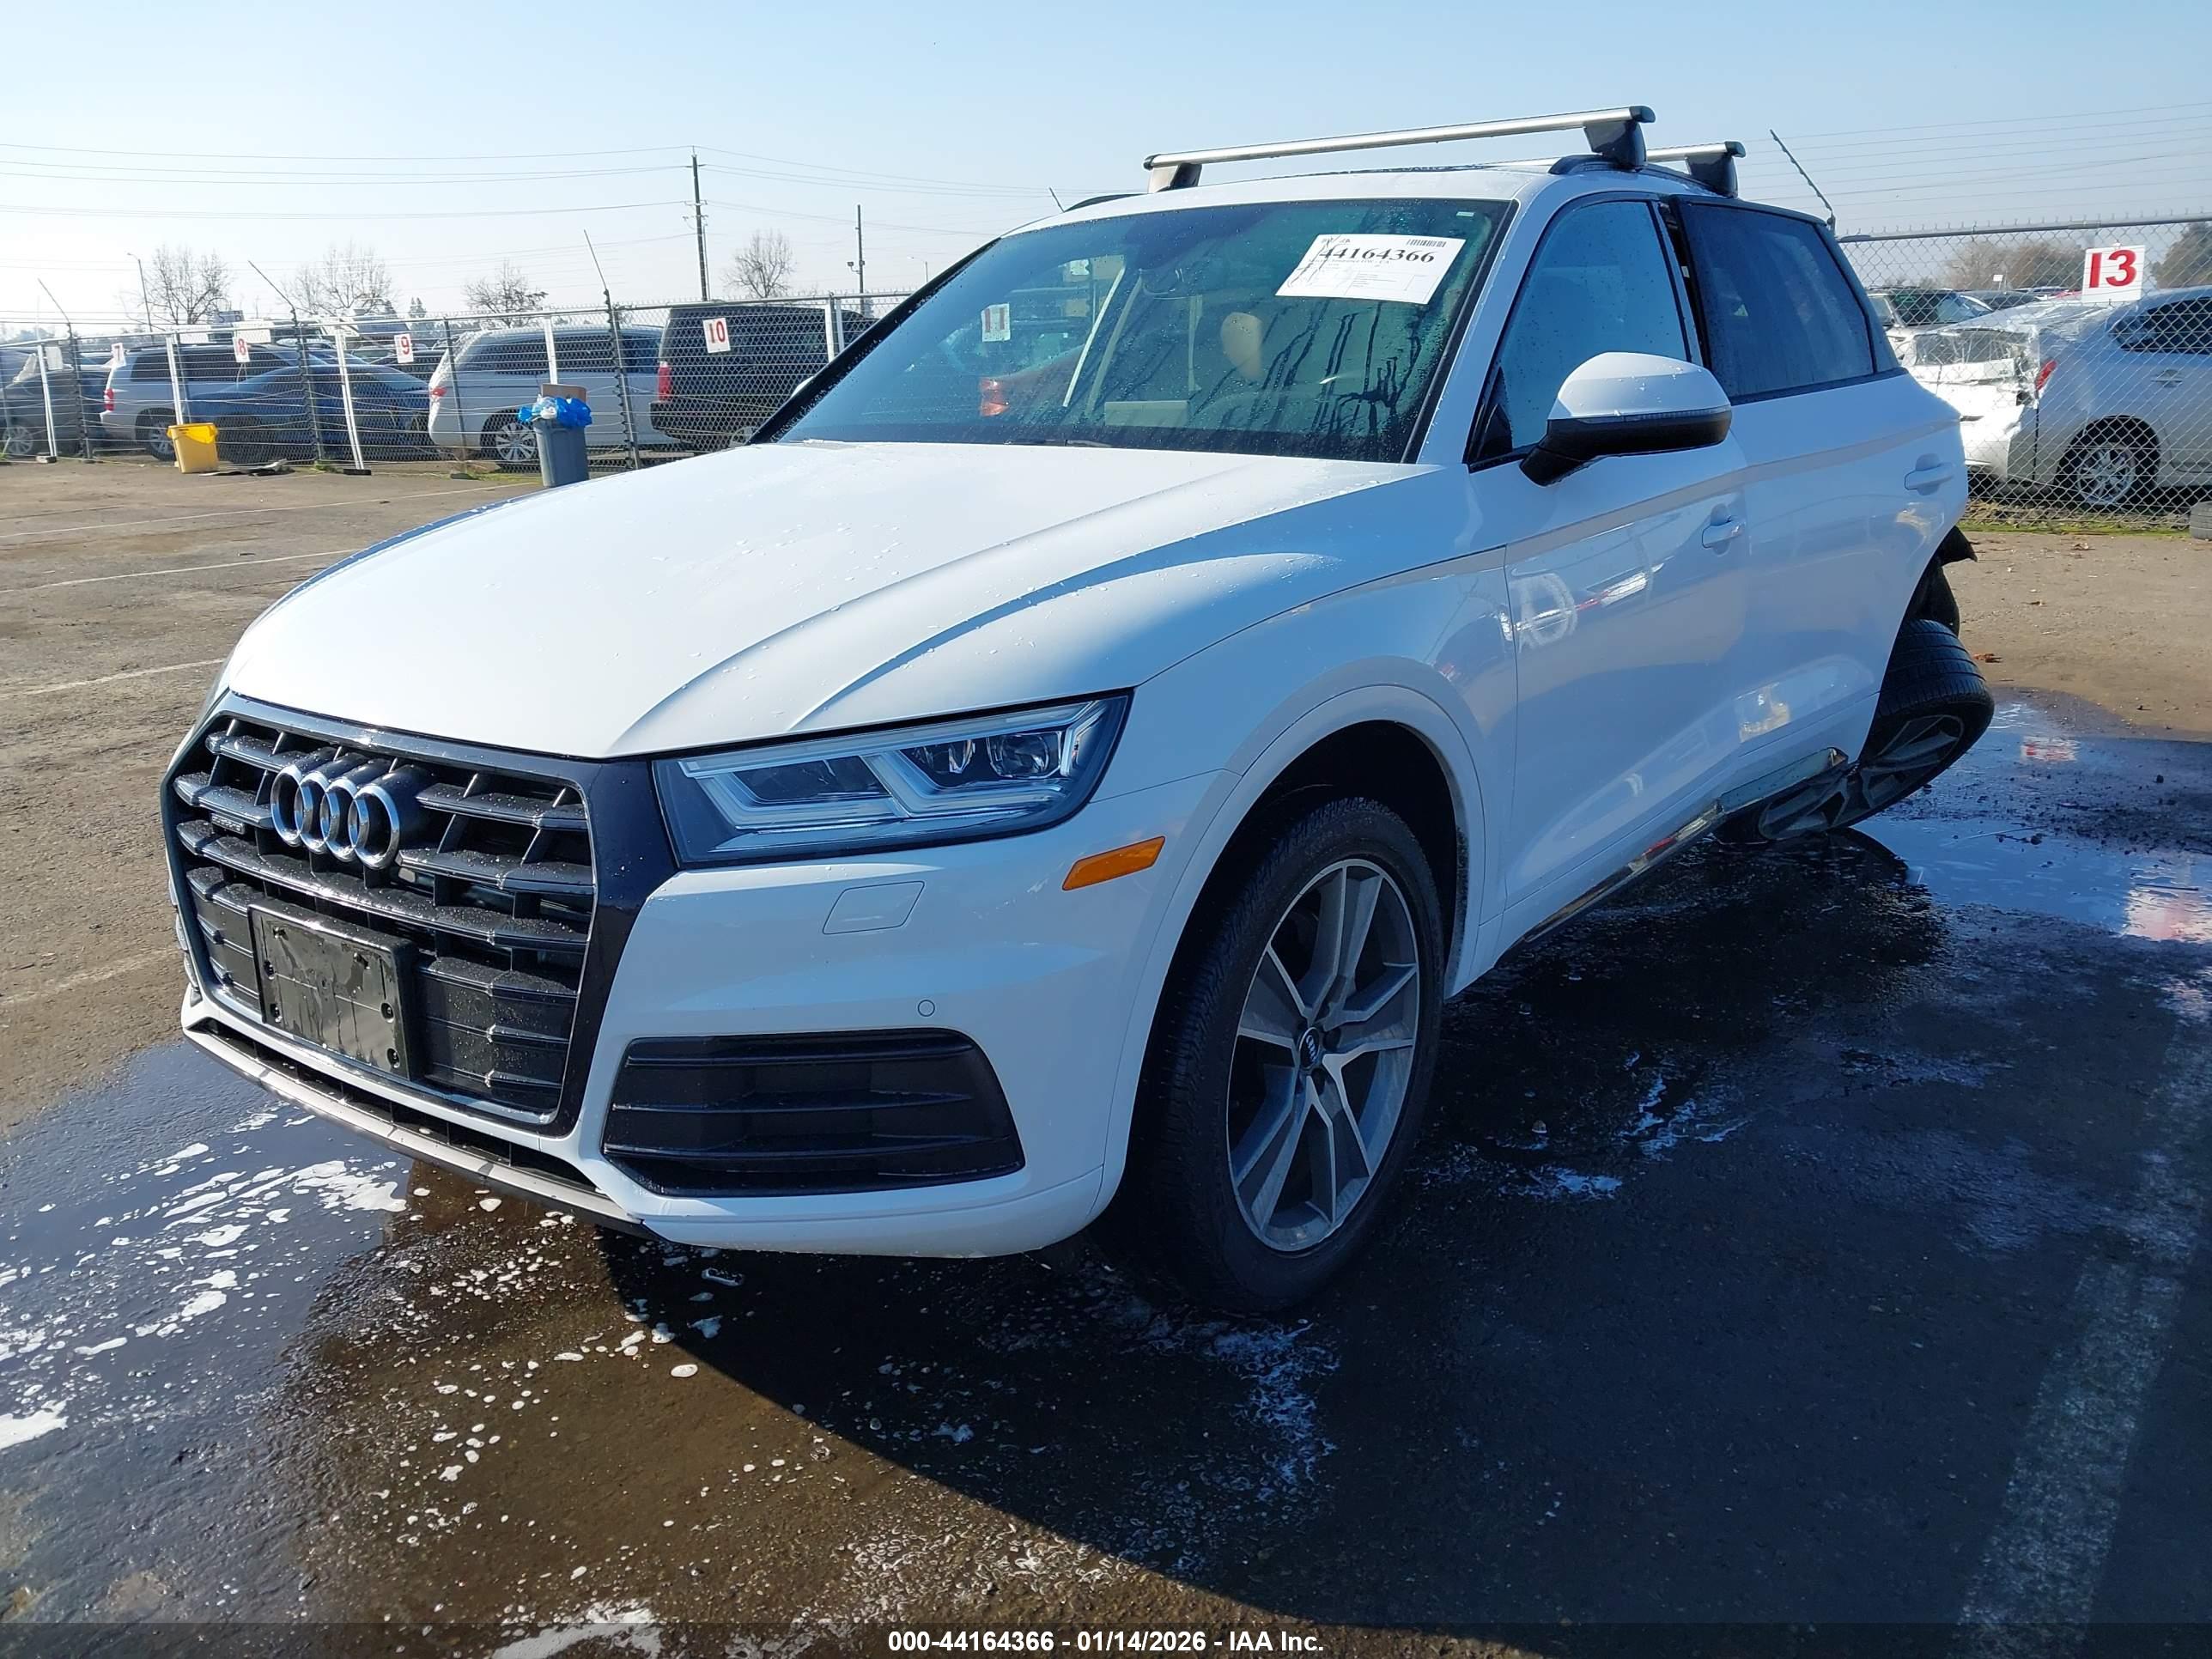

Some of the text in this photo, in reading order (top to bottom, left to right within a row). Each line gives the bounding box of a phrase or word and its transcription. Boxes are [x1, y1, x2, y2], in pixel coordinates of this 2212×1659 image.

[1319, 246, 1437, 264] 44164366
[2089, 250, 2137, 289] 13
[708, 320, 726, 344] 10
[238, 338, 246, 356] 8
[401, 336, 410, 356] 9
